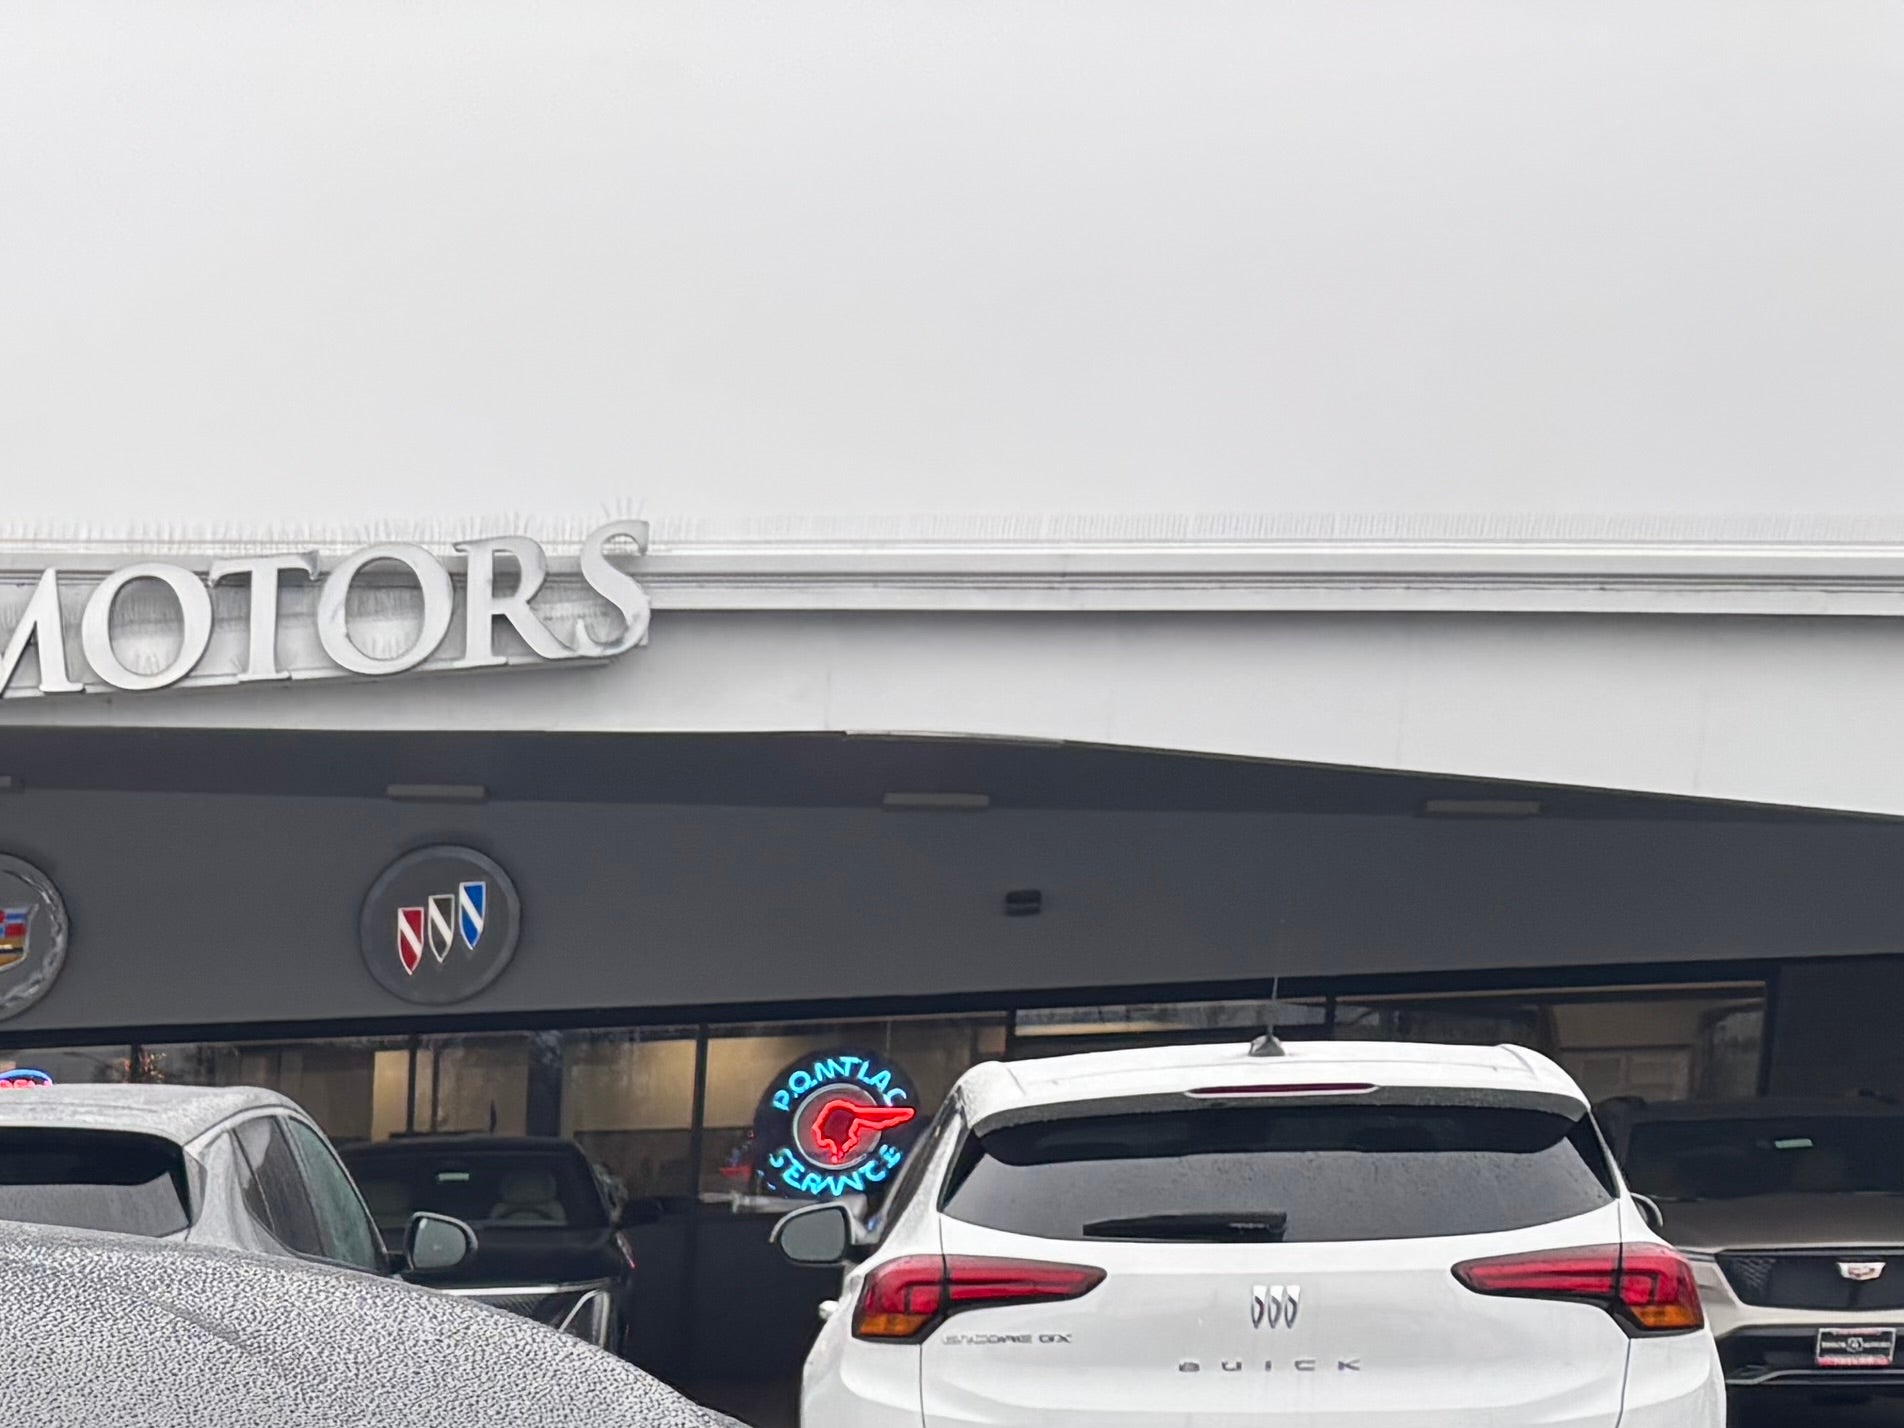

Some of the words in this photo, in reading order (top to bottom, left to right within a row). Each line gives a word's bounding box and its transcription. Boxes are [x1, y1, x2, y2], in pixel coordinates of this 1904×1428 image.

[770, 1055, 907, 1112] PONTIAC
[769, 1143, 903, 1197] SERVICE
[1178, 1358, 1360, 1373] BUICK
